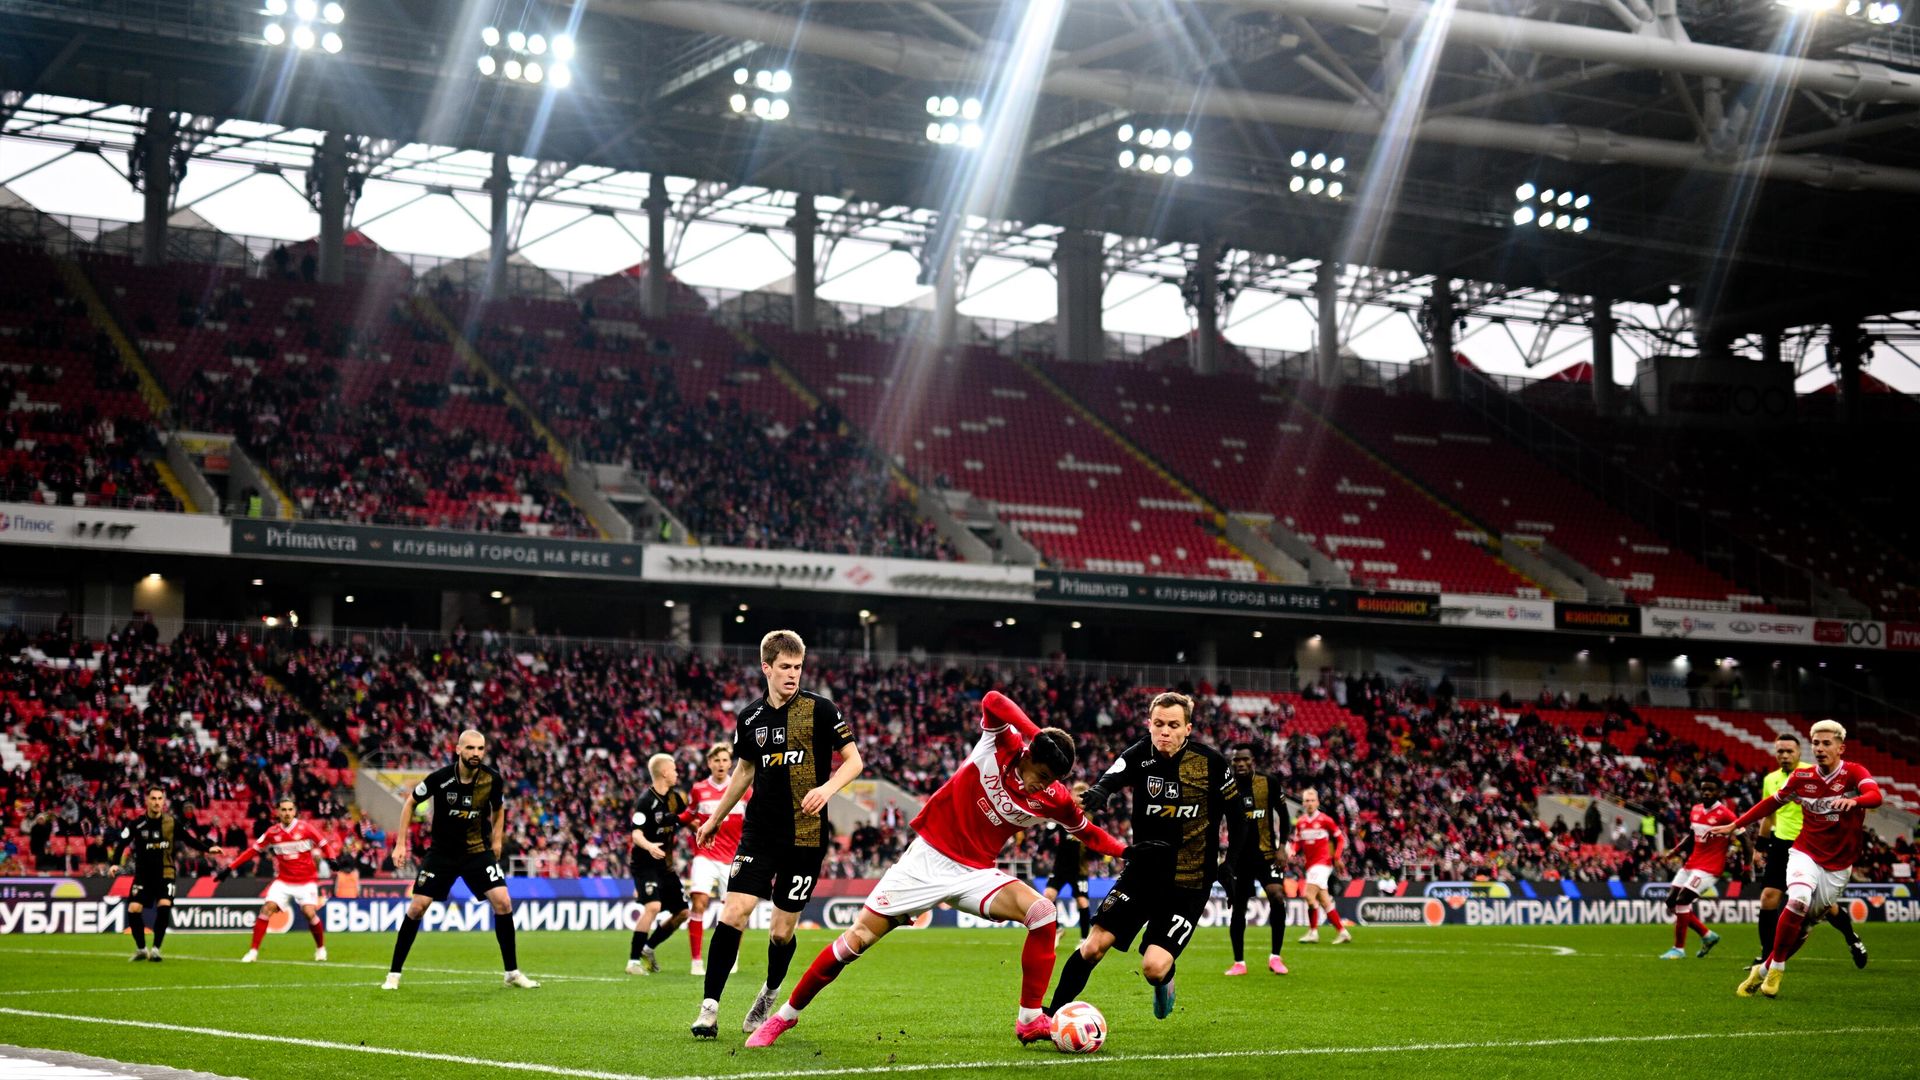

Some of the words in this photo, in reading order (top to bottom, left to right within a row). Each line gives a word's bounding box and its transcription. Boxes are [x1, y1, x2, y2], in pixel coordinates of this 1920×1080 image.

[14, 515, 55, 533] Плюс
[266, 528, 357, 551] Primavera
[393, 539, 474, 558] КЛУБНЫЙ
[480, 544, 538, 564] ГОРОД
[543, 549, 565, 563] НА
[571, 550, 610, 567] РЕКЕ
[1059, 577, 1129, 598] Primavera
[1154, 586, 1217, 602] КЛУБНЫЙ
[1221, 590, 1266, 606] ГОРОД
[1269, 593, 1286, 606] НА
[1290, 594, 1320, 608] РЕКЕ
[1759, 622, 1805, 636] CHERY
[1842, 622, 1881, 645] 100
[762, 750, 804, 768] PARI
[1146, 804, 1199, 818] PARI
[485, 863, 505, 882] 24
[788, 875, 812, 901] 22
[170, 906, 258, 929] Winline
[326, 897, 490, 932] ВЫИРАЙ
[1465, 895, 1573, 925] ВЫИГРАЙ
[1579, 899, 1678, 925] МИЛЛИО
[1699, 899, 1761, 925] РУБЛЕ
[1166, 914, 1193, 946] 77
